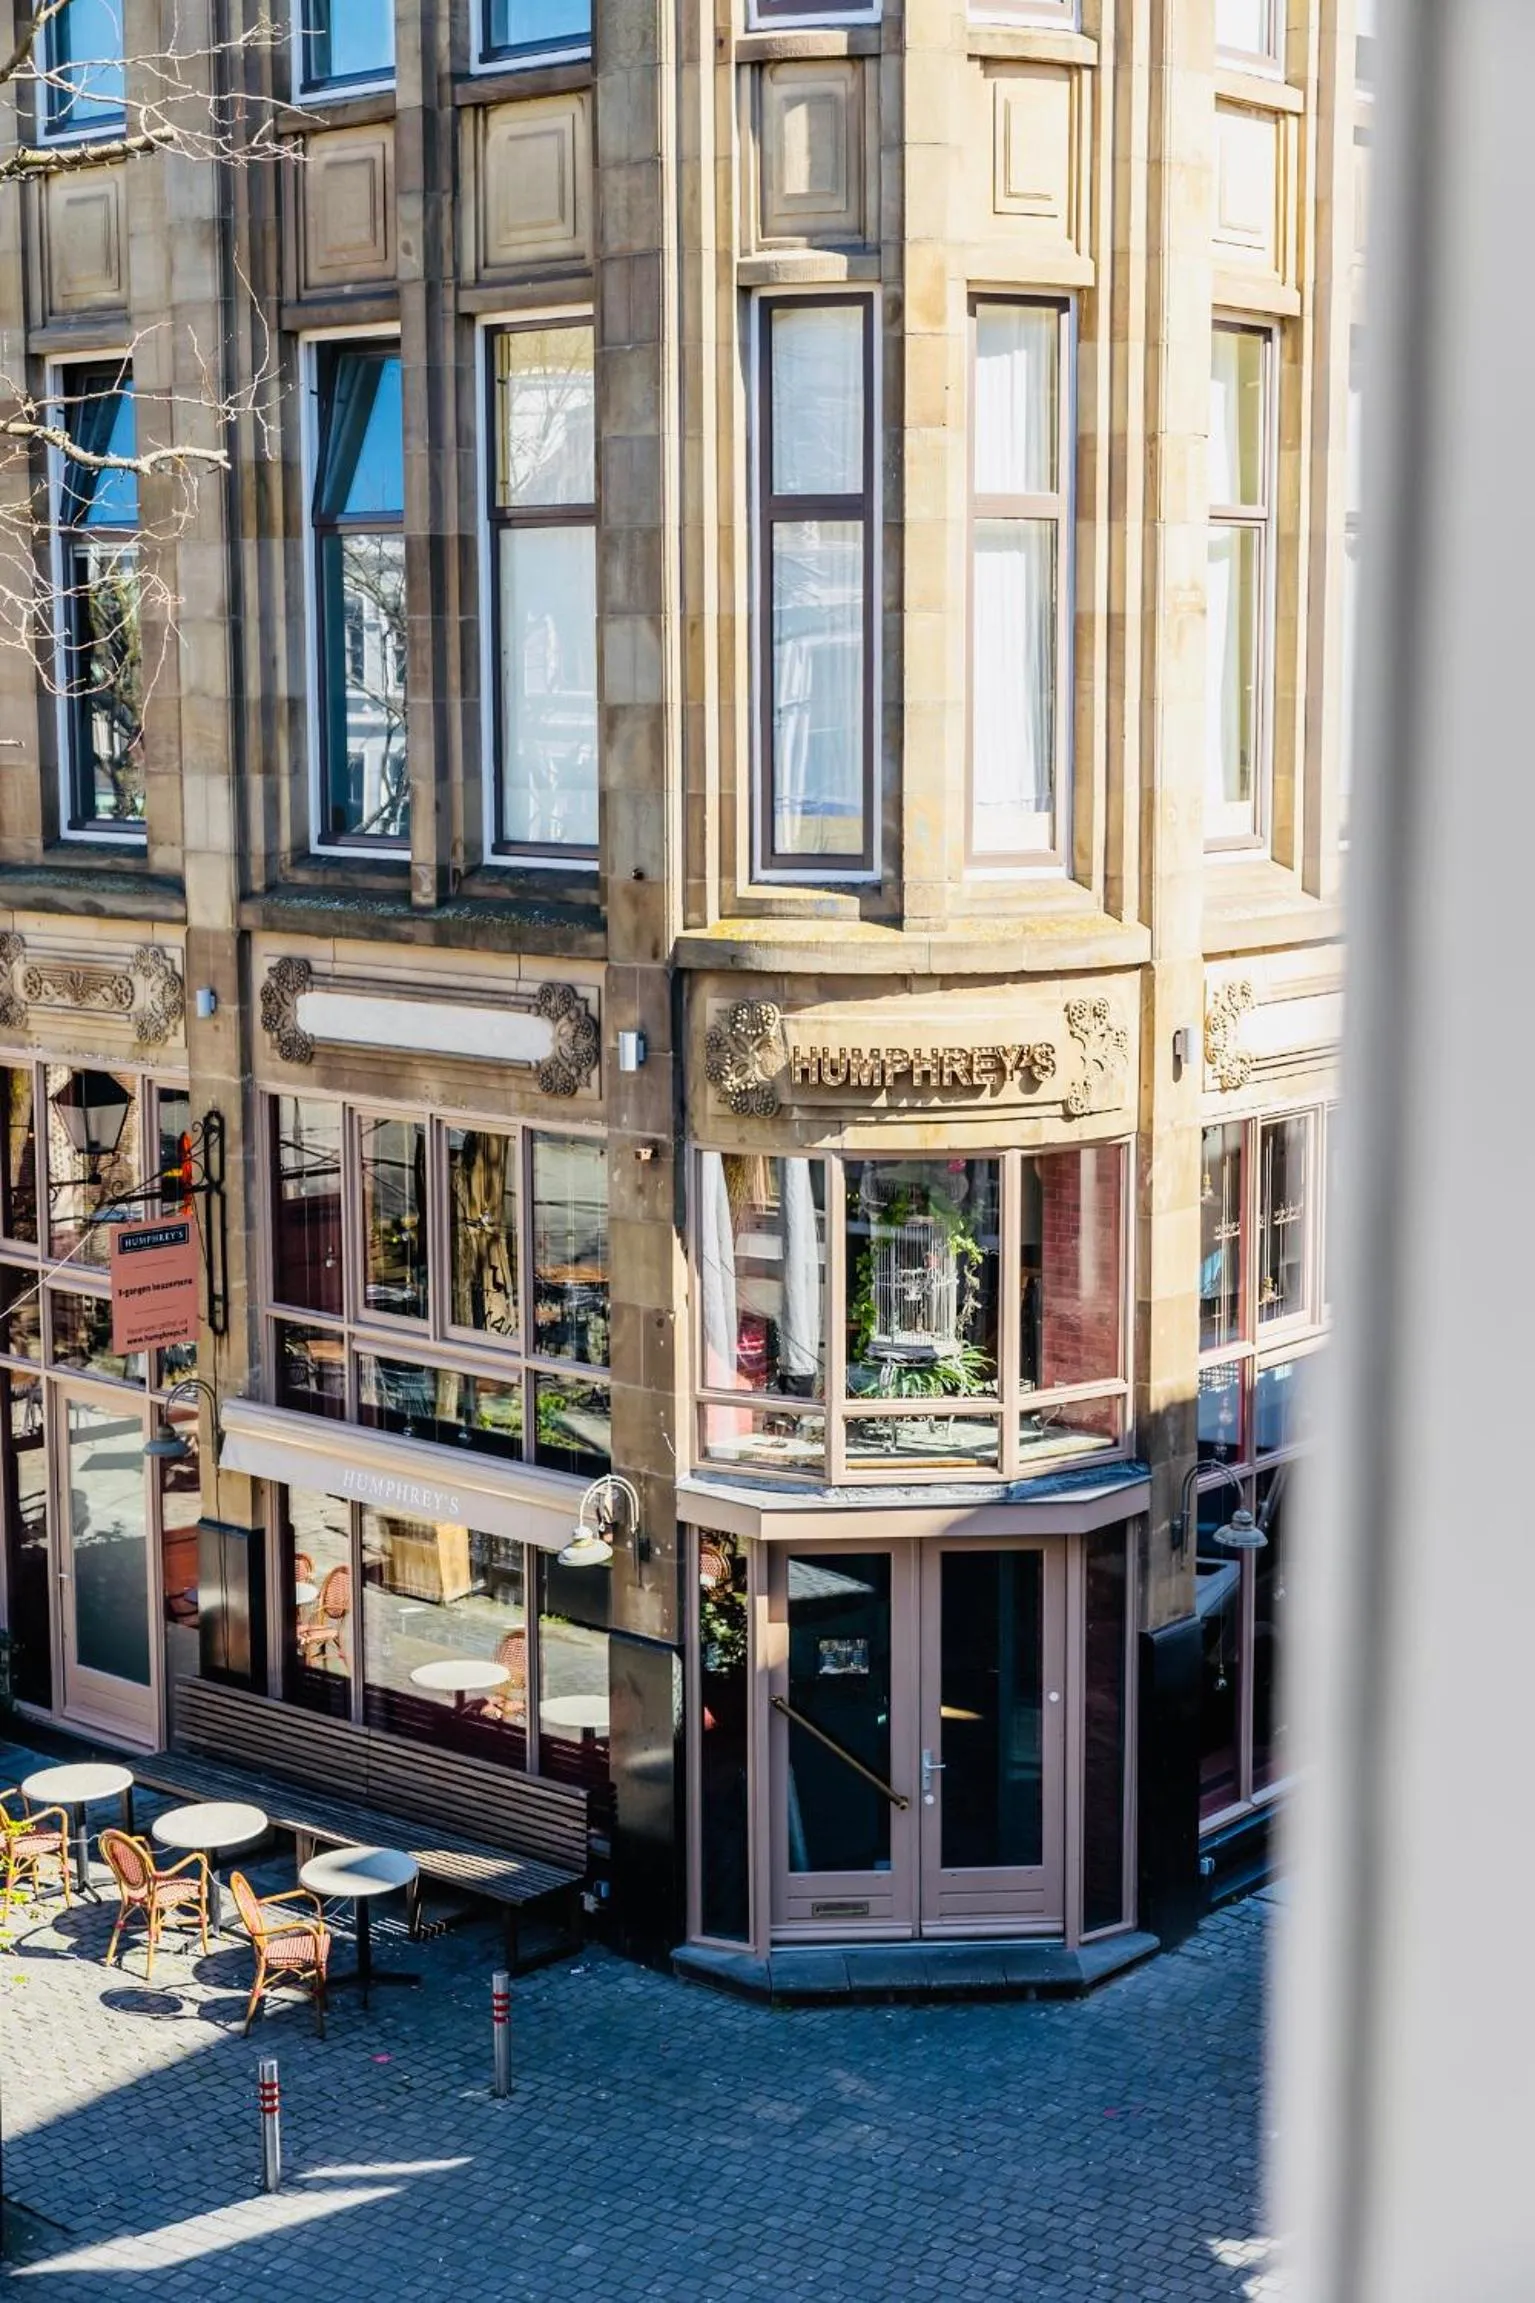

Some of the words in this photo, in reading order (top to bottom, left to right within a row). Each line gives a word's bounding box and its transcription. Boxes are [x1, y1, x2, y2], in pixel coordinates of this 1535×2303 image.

[791, 1042, 1056, 1087] HUMPHREY'S
[125, 1231, 184, 1248] HUMPHREY'S
[343, 1469, 460, 1515] HUMPHREY'S
